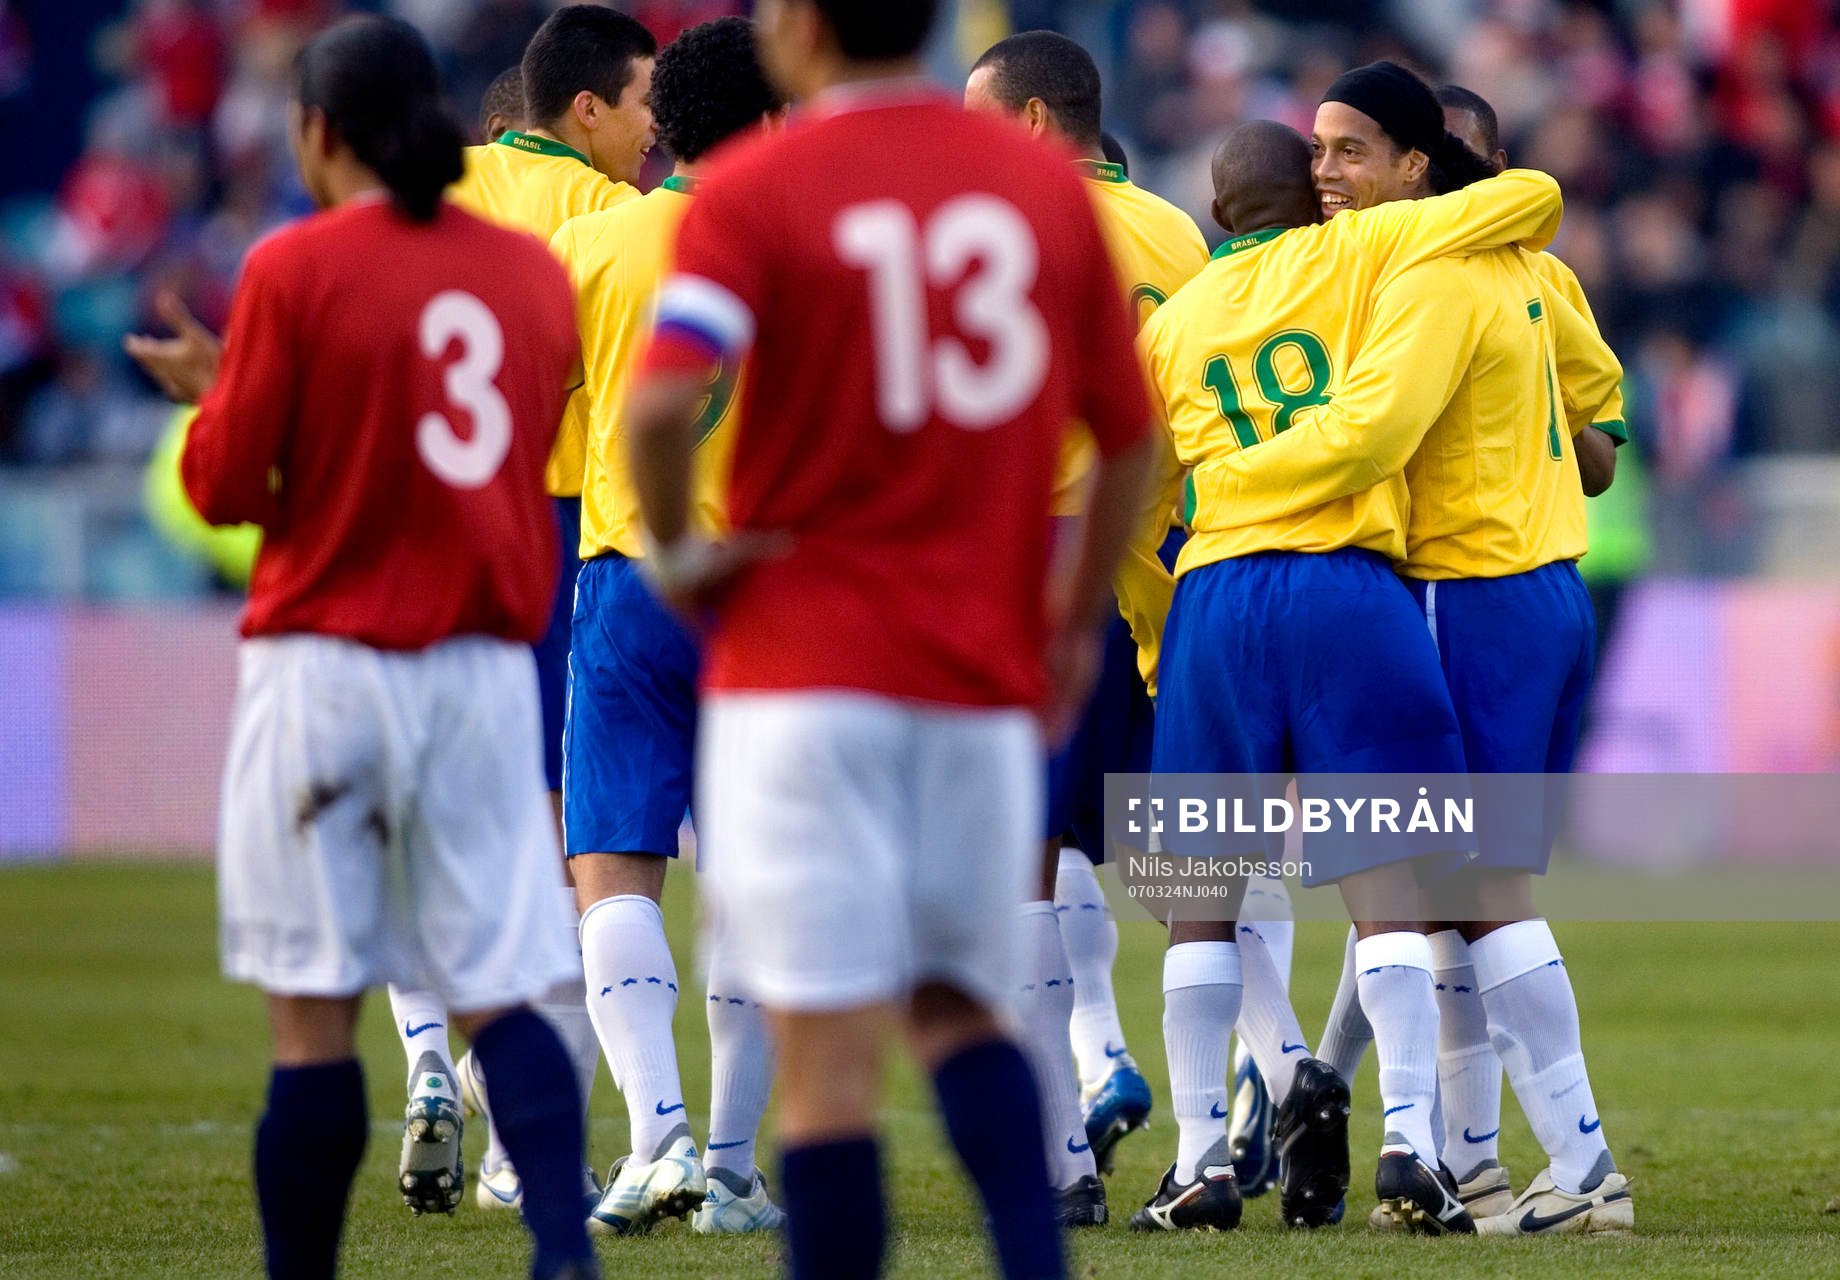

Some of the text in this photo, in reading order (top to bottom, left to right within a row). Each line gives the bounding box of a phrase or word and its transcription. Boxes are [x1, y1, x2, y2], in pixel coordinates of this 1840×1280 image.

[513, 137, 542, 151] BRASIL
[1231, 237, 1260, 250] BRASIL
[832, 193, 1051, 433] 13
[416, 290, 513, 488] 3
[1202, 329, 1336, 451] 18
